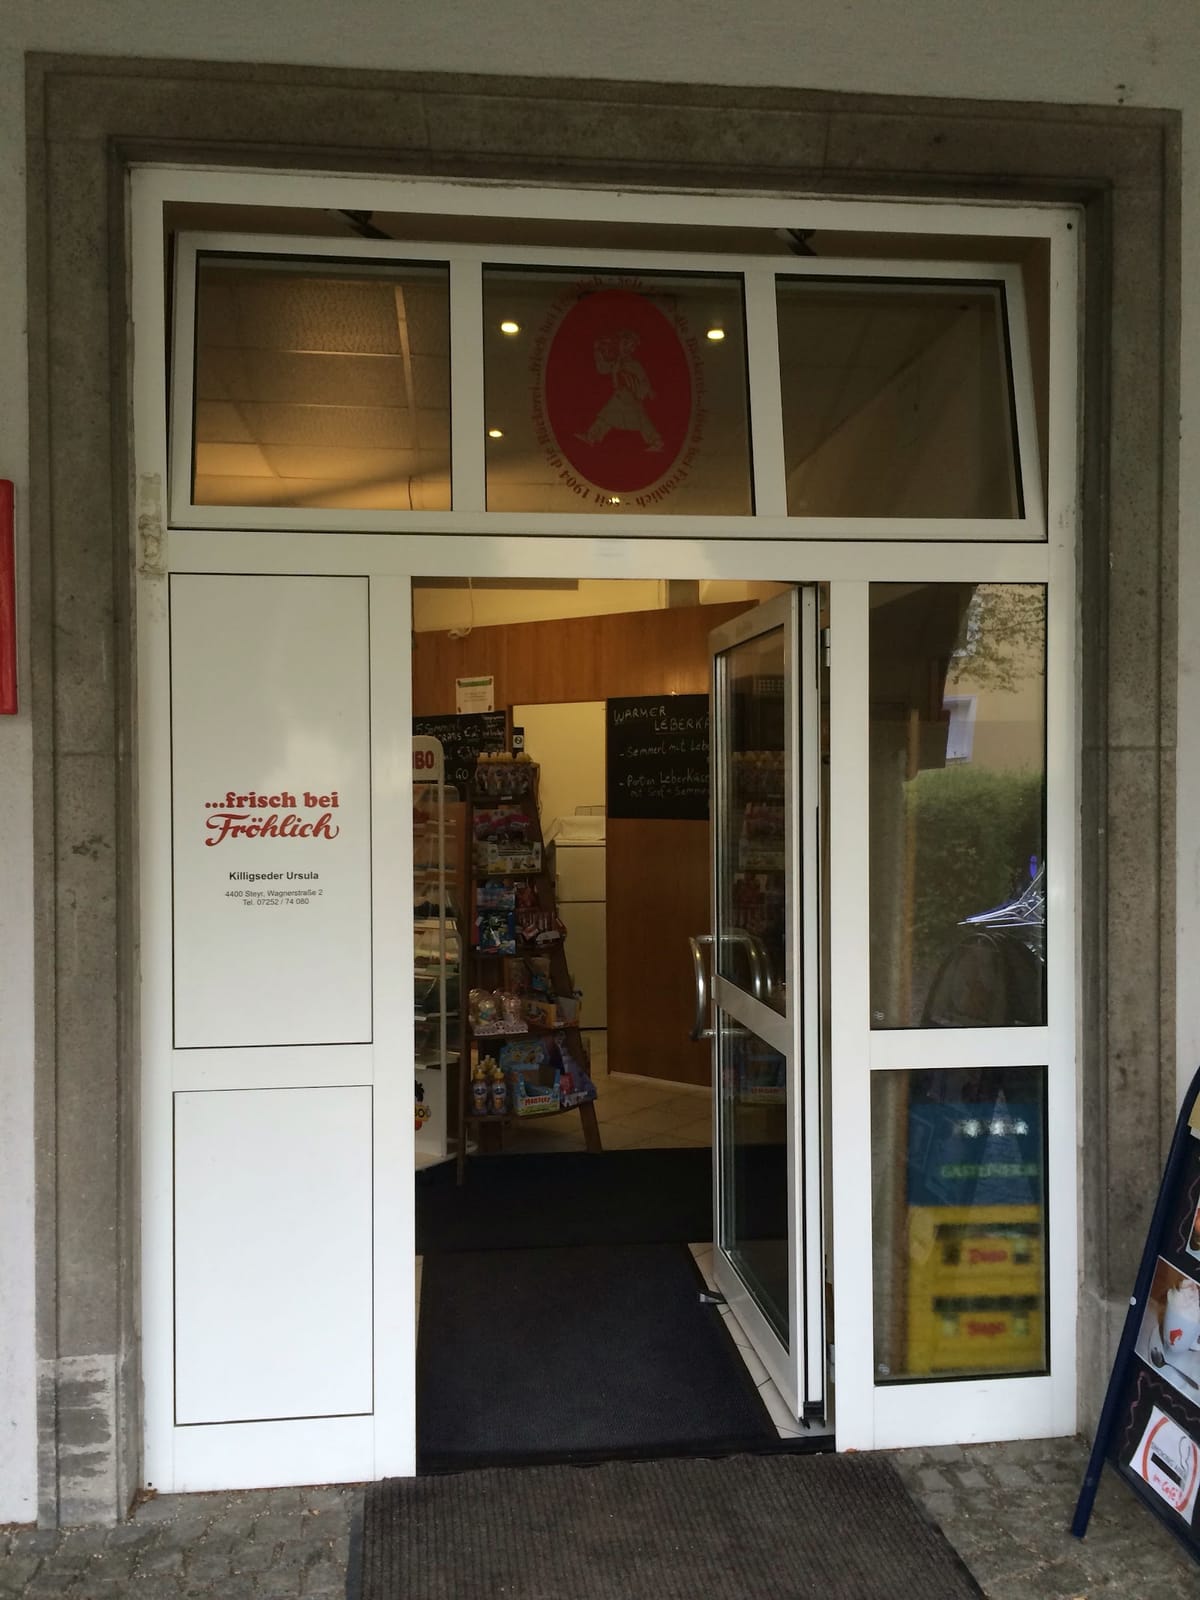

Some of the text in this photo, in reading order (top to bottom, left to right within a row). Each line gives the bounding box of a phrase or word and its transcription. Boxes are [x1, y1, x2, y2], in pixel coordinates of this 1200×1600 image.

[558, 468, 592, 501] 1904
[303, 791, 340, 808] bei
[205, 812, 340, 847] Fröhlich
[229, 871, 319, 882] Killigseder Ursula
[225, 890, 243, 898] 4400
[318, 888, 323, 896] 2
[256, 898, 280, 906] 07252
